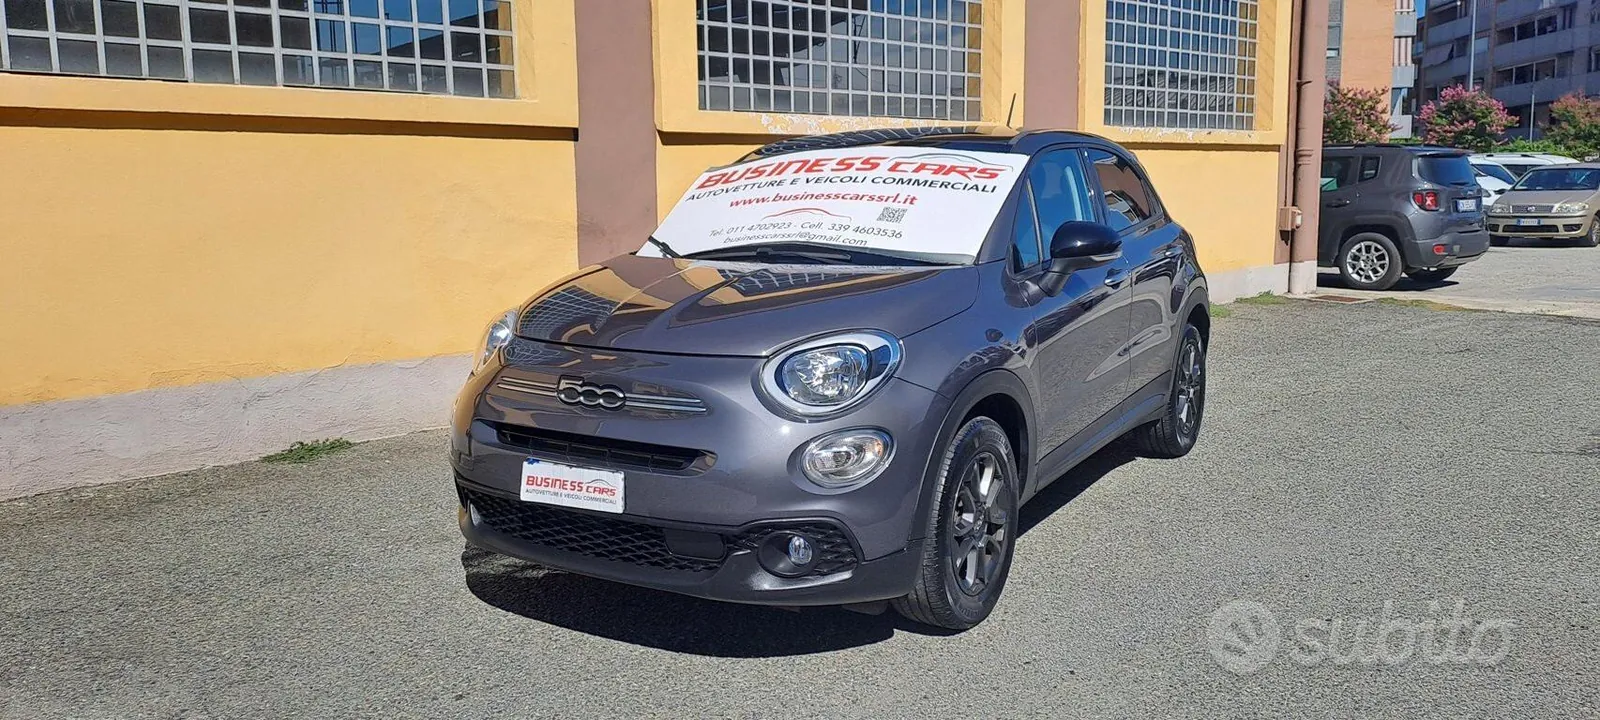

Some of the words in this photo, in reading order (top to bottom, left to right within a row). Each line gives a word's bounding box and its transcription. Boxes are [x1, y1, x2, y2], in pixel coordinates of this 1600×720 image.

[696, 156, 889, 189] BUSINESS
[887, 161, 1006, 180] CARS
[687, 179, 787, 200] AUTOVETTURE
[789, 177, 801, 186] E
[805, 175, 868, 184] VEICOLI
[871, 176, 997, 193] COMMERCIALI
[729, 191, 918, 208] www.businesscarssrl.it
[723, 231, 868, 247] businesscarssrl@gmail.com
[747, 222, 792, 232] 4702923
[800, 221, 823, 230] Cell.
[828, 223, 850, 232] 339
[852, 225, 903, 239] 4603536
[558, 375, 625, 407] 500
[526, 475, 584, 492] BUSINESS
[586, 485, 617, 497] CARS
